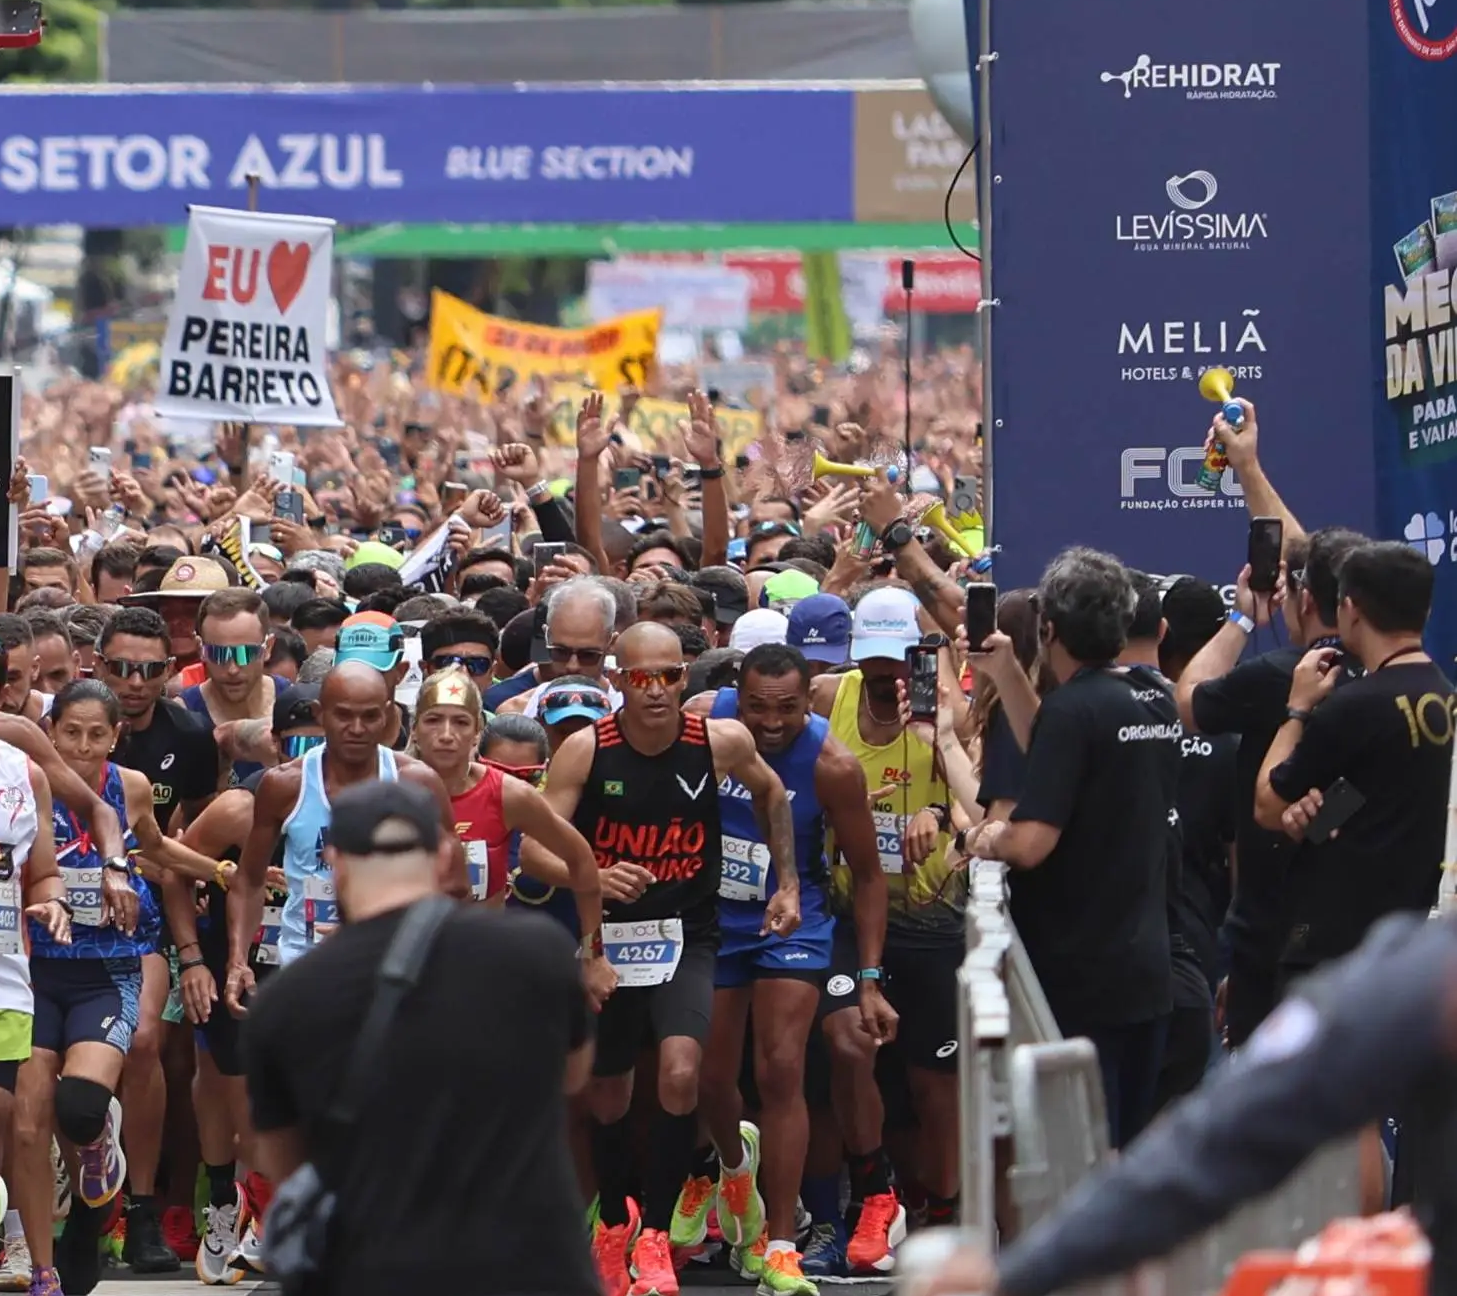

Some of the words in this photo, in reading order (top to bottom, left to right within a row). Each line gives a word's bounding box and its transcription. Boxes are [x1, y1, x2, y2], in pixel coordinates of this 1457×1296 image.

[1133, 63, 1281, 88] REHIDRAT
[1186, 89, 1218, 100] RÁPIDA
[229, 134, 403, 189] AZUL
[446, 146, 532, 178] BLUE
[540, 146, 693, 179] SECTION
[1134, 242, 1158, 252] ÁGUA
[1163, 242, 1204, 251] MINERAL
[1209, 241, 1251, 251] NATURAL
[202, 244, 262, 306] EU
[180, 314, 310, 364] PEREIRA
[168, 358, 322, 408] BARRETO
[1121, 367, 1178, 381] HOTELS
[1121, 500, 1178, 511] FUNDAÇÃO
[1182, 497, 1224, 509] CÁSPER
[595, 816, 706, 858] UNIÃO
[617, 943, 665, 963] 4267
